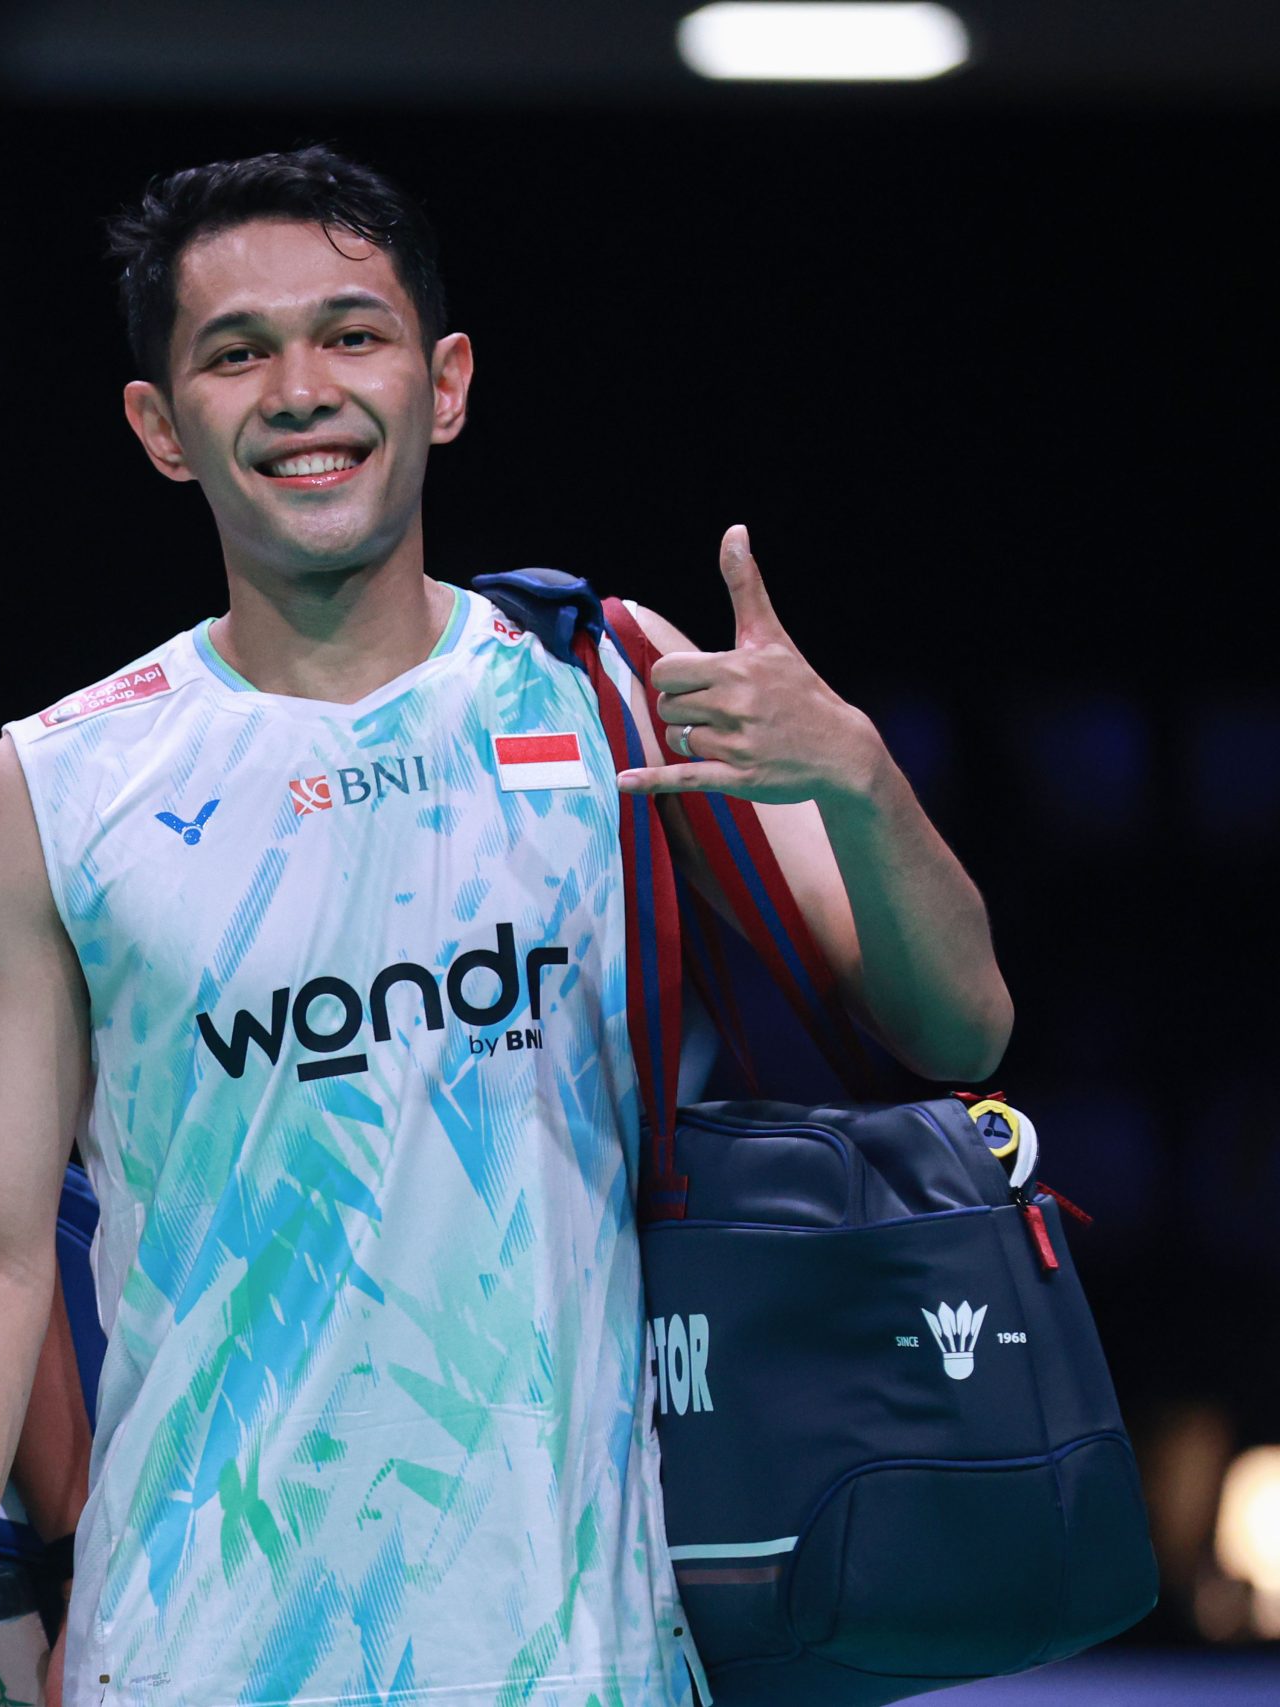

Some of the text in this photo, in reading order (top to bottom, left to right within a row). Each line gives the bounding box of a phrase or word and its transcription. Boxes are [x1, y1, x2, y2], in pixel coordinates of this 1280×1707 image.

[84, 666, 162, 701] Kapal Api
[88, 689, 135, 708] Group
[337, 756, 429, 805] BNI
[196, 922, 569, 1079] wondr
[469, 1028, 543, 1057] by BNI
[895, 1332, 1027, 1348] SINCE 1968
